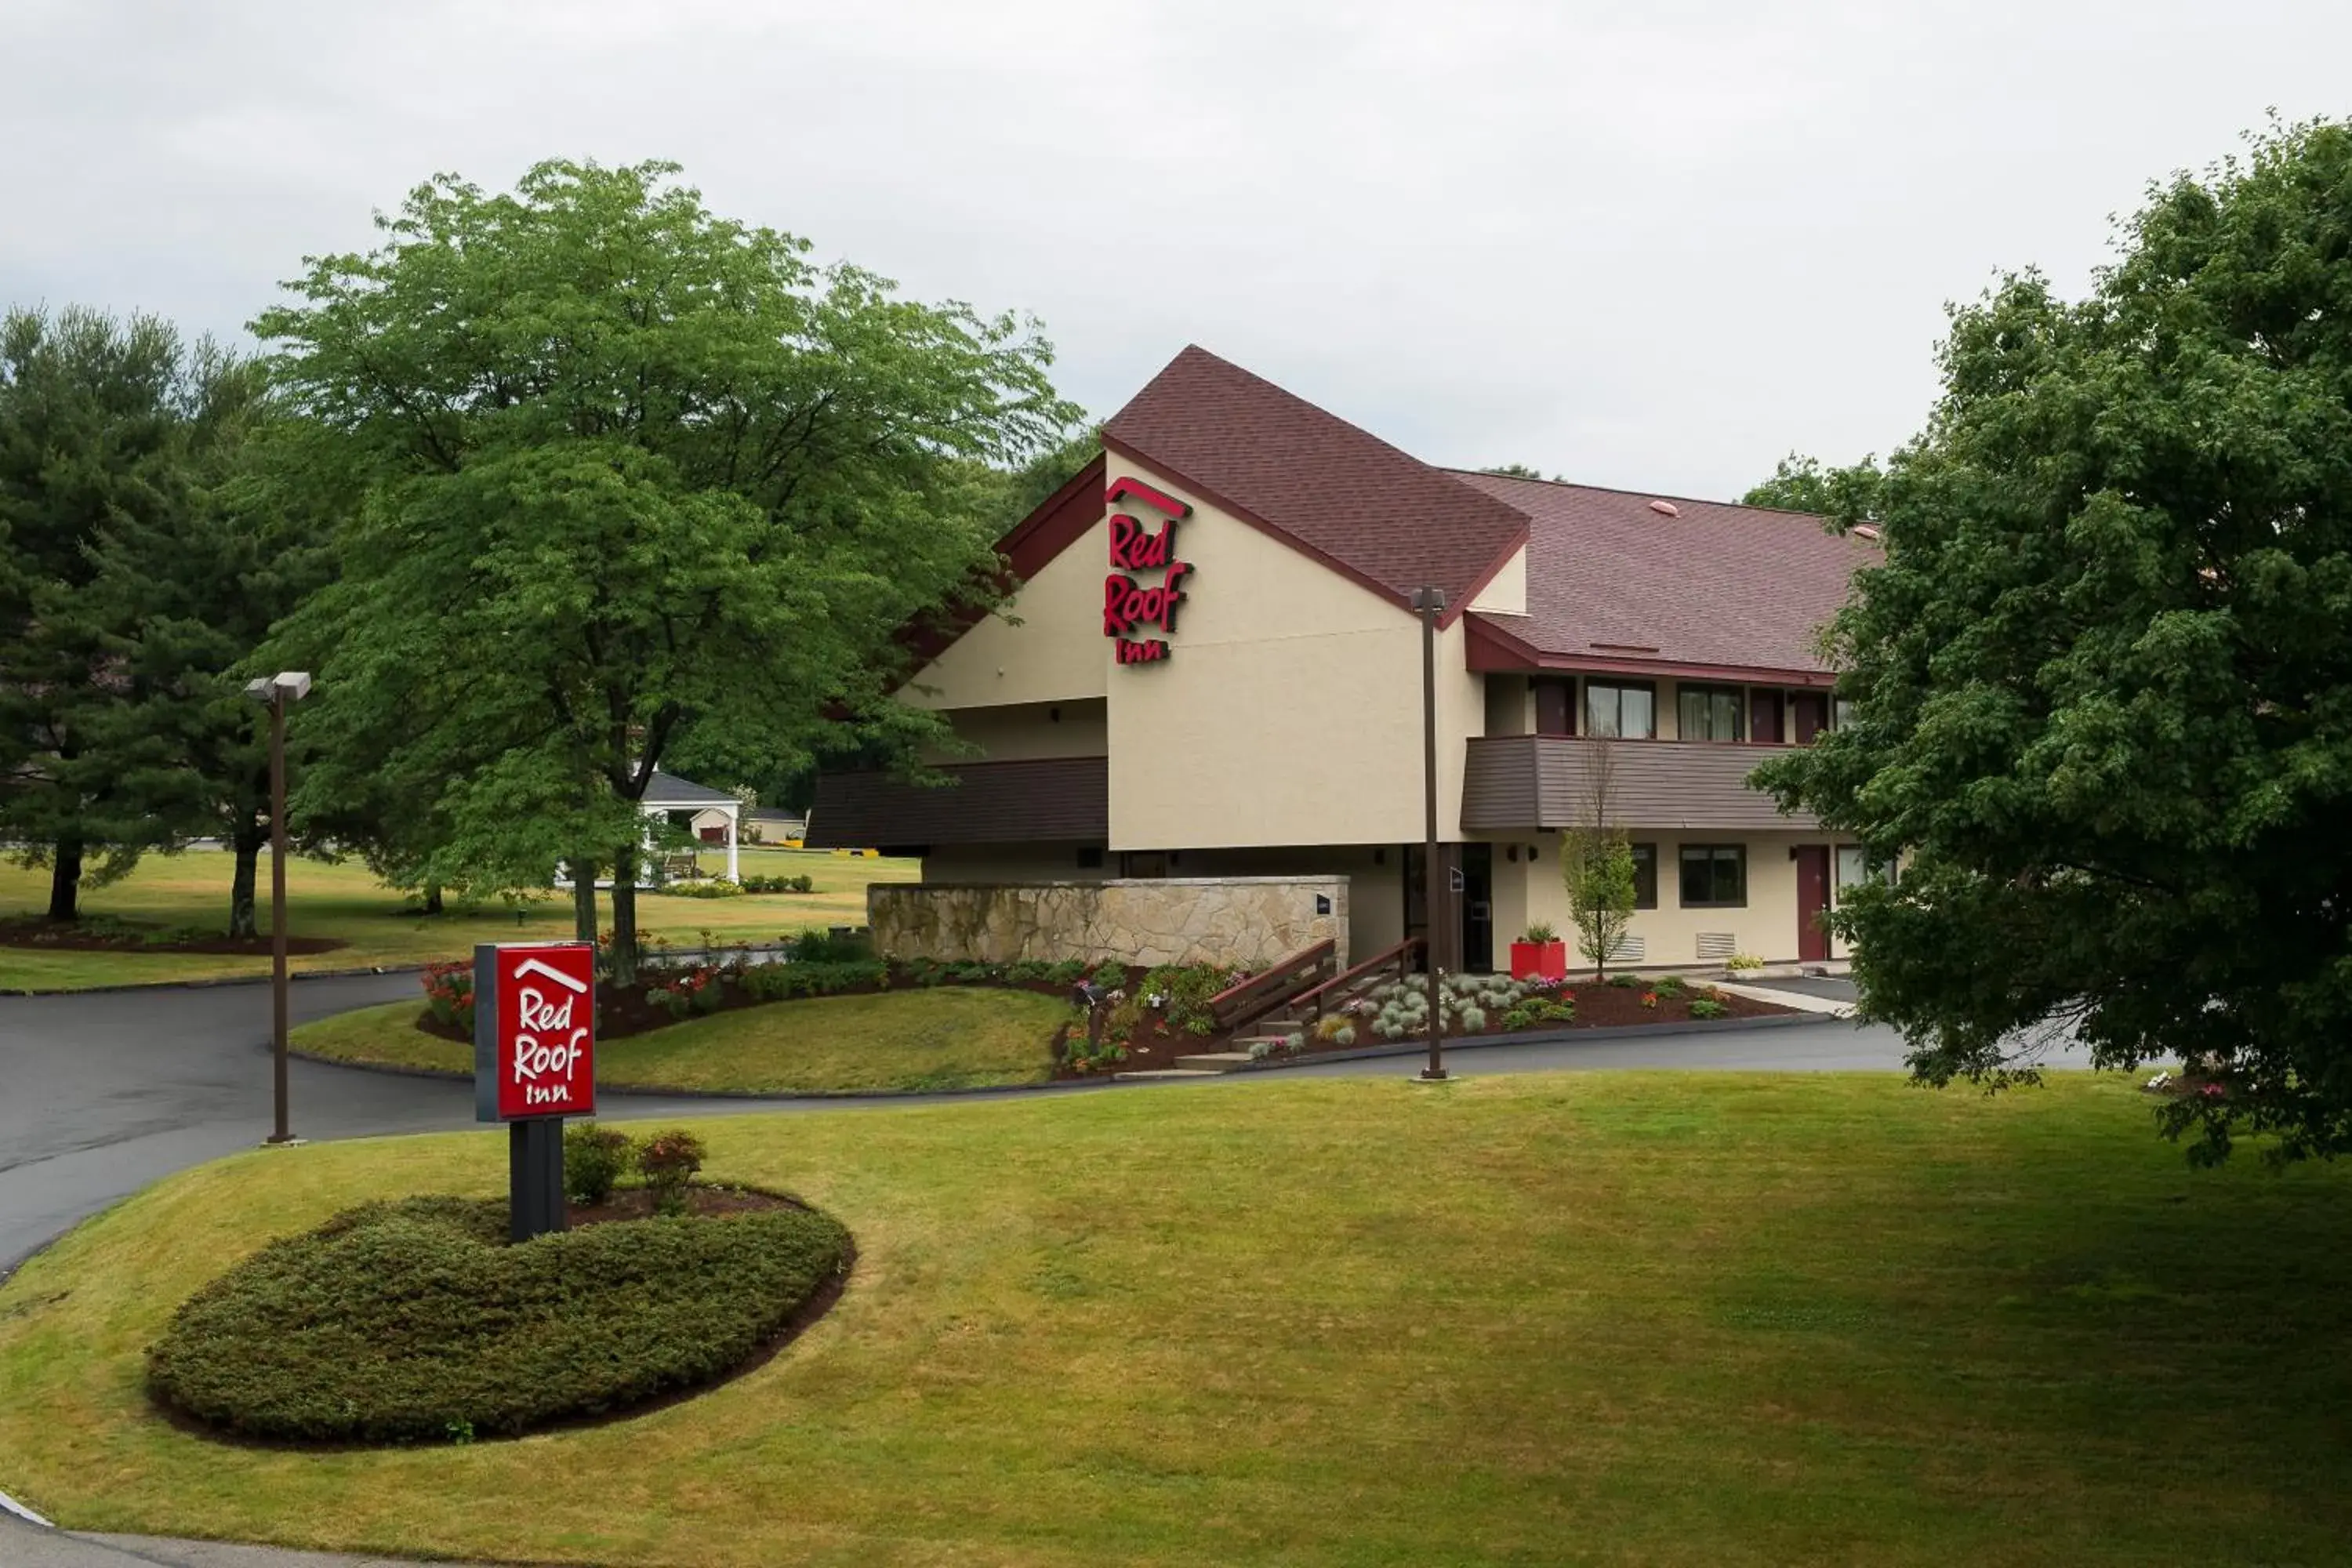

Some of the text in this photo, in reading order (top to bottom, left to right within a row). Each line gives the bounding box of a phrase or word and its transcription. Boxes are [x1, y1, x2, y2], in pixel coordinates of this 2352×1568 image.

[1109, 514, 1174, 570] Red
[1104, 561, 1192, 637] Roof
[1116, 638, 1167, 664] Inn
[519, 987, 573, 1032] Red
[514, 1027, 588, 1084] Roof
[526, 1083, 568, 1105] Inn
